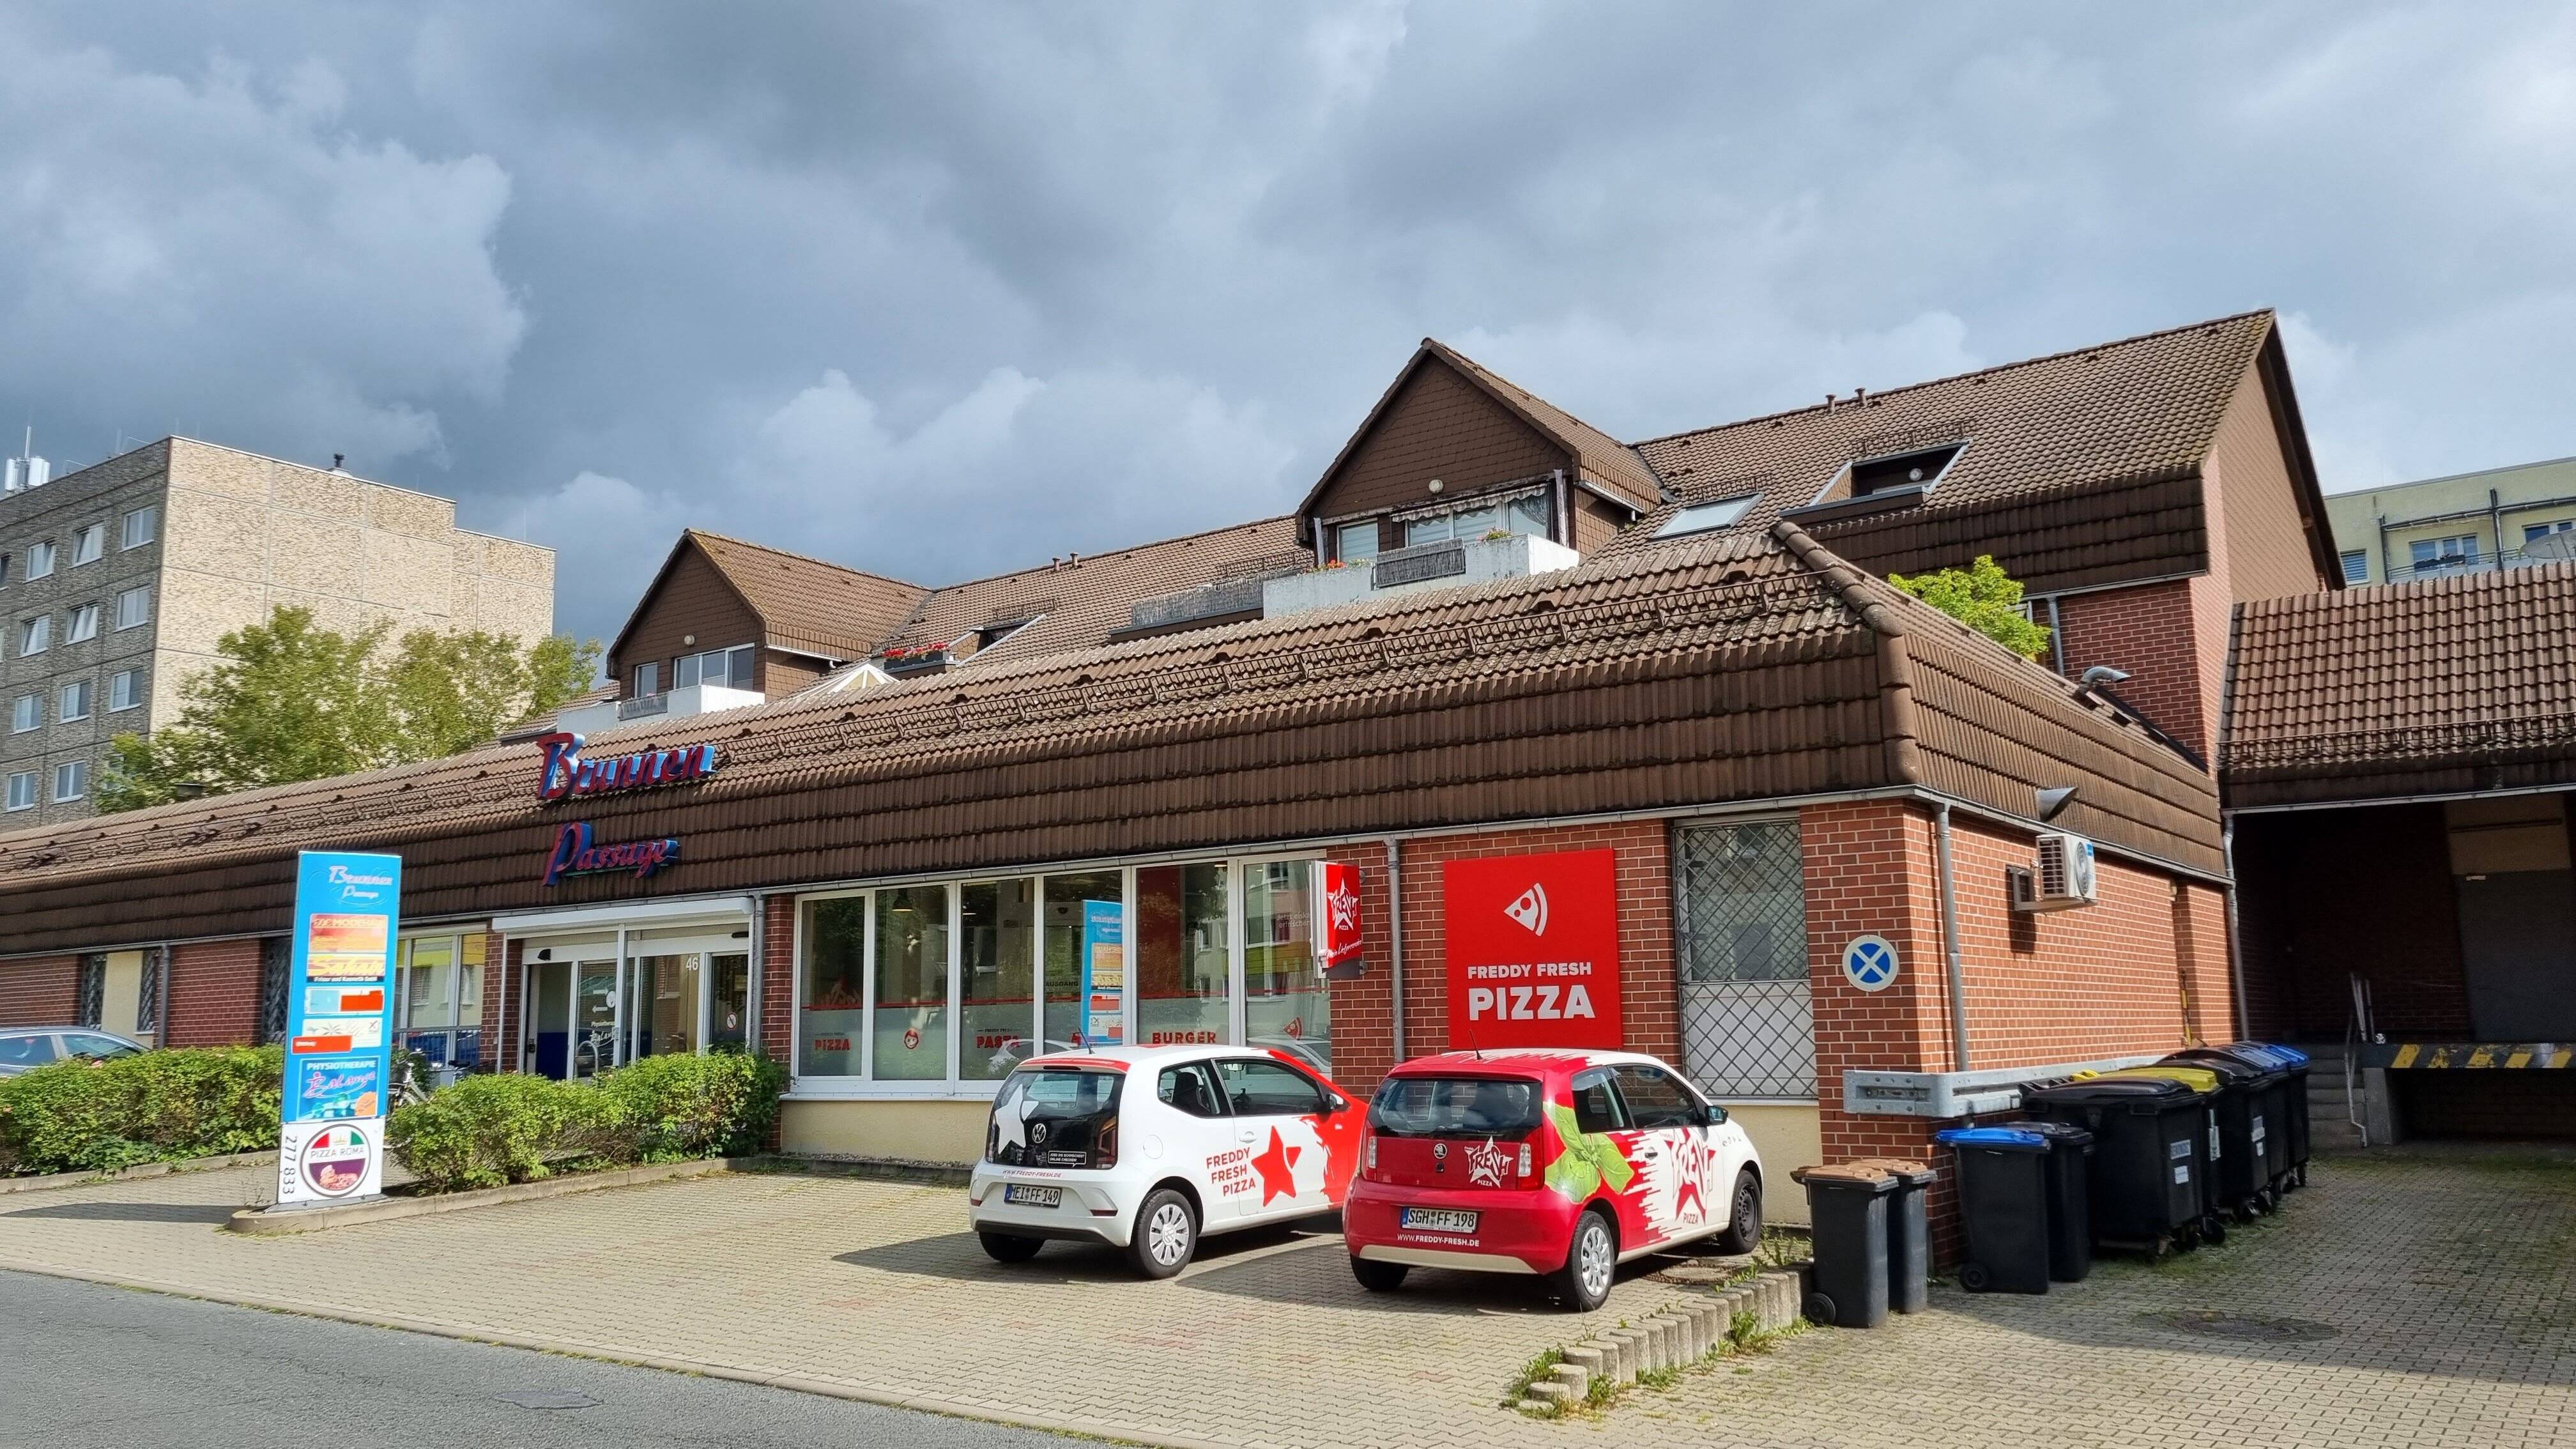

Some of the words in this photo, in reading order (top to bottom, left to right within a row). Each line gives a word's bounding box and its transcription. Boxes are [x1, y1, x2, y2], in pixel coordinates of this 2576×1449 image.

[537, 732, 714, 799] Brunnen
[543, 822, 678, 887] Passage
[686, 957, 699, 970] 46
[1468, 965, 1531, 979] FREDDY
[1537, 962, 1591, 976] FRESH
[1469, 985, 1596, 1021] PIZZA
[815, 1039, 850, 1051] PIZZA
[1153, 1032, 1216, 1044] BURGER
[307, 1061, 376, 1070] PHYSIOTHERAPIE
[284, 1135, 298, 1162] 277
[310, 1149, 337, 1158] PIZZA
[339, 1146, 364, 1156] ROMA
[1206, 1147, 1250, 1169] FREDDY
[282, 1167, 296, 1194] 833
[1211, 1163, 1247, 1184] FRESH
[1223, 1177, 1255, 1196] PIZZA
[1030, 1189, 1042, 1201] FF
[1042, 1190, 1059, 1203] 149
[1409, 1209, 1429, 1224] SGH
[1436, 1211, 1452, 1225] FF
[1453, 1213, 1475, 1227] 198
[1683, 1213, 1698, 1225] PIZZA
[1397, 1233, 1480, 1247] WWW.FREDDY-FRESH.DE
